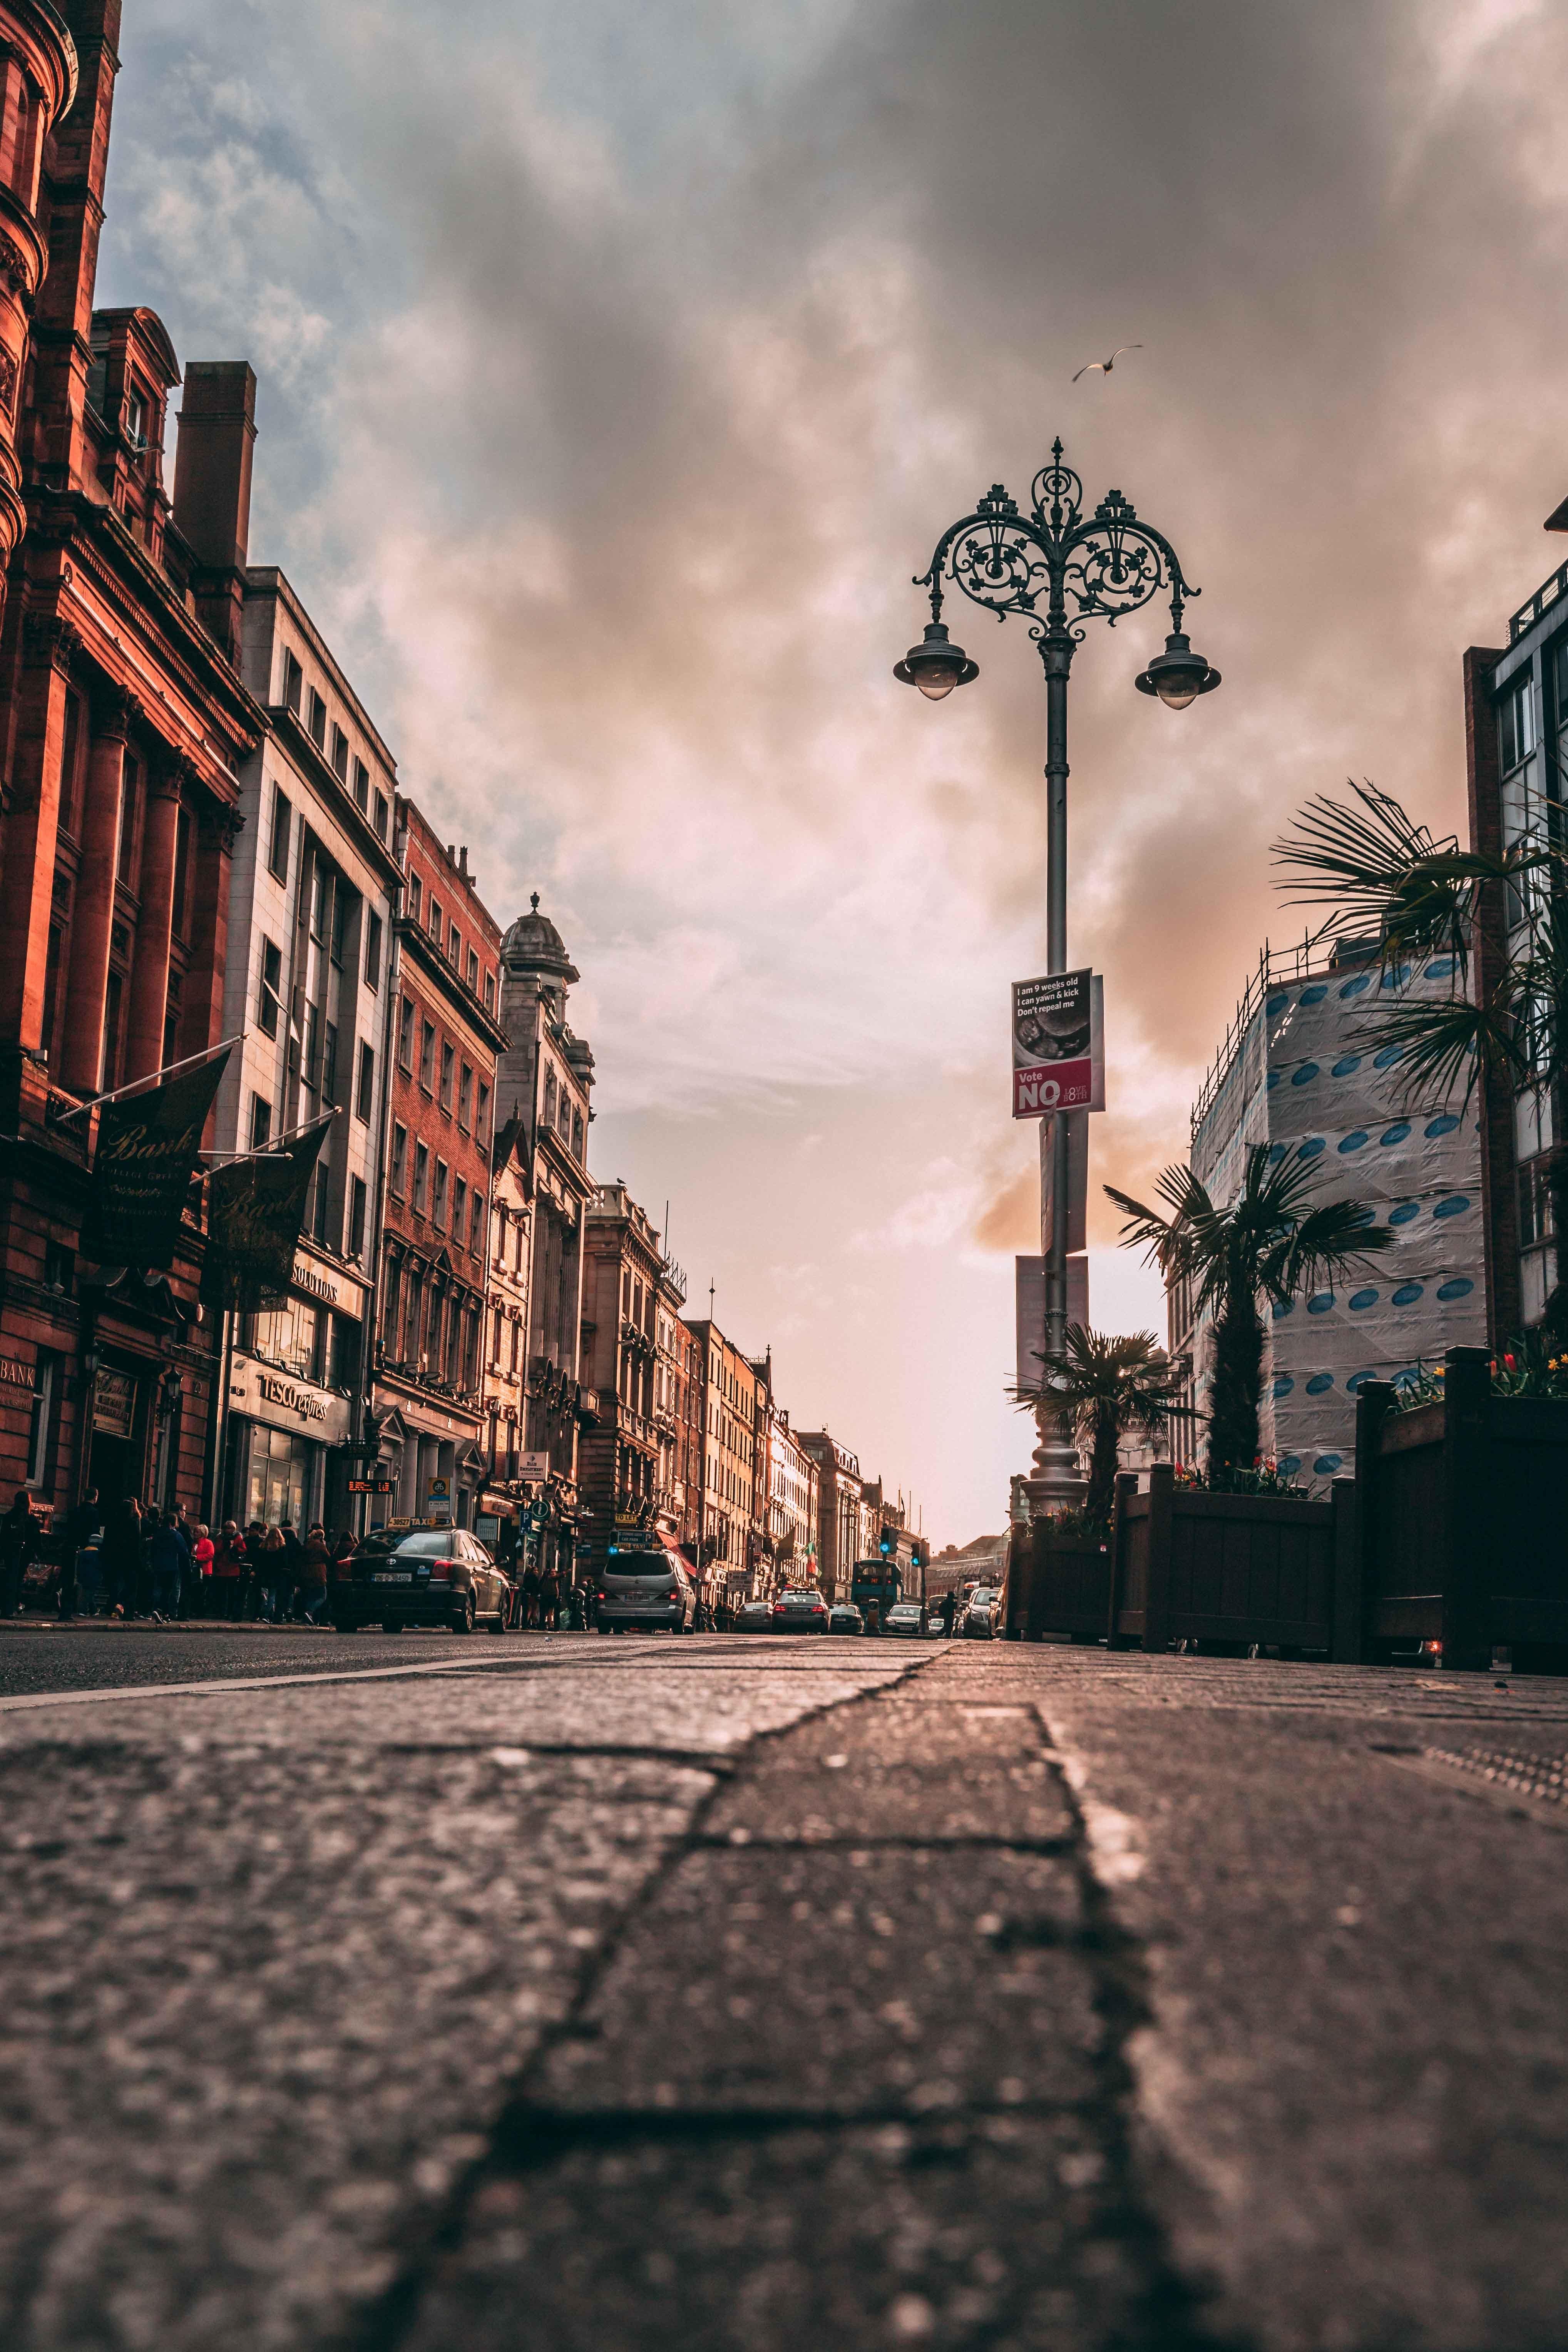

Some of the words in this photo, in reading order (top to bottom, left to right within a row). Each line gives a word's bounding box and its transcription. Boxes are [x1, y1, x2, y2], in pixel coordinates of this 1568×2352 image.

[1021, 986, 1033, 995] am
[1034, 984, 1039, 992] 9
[1041, 981, 1064, 991] weeks
[1066, 977, 1078, 986] old
[1021, 997, 1034, 1005] can
[1036, 994, 1055, 1004] yawn
[1064, 988, 1079, 997] kick
[1017, 1006, 1038, 1017] Don't
[1039, 1001, 1061, 1014] repeal
[1019, 1072, 1043, 1083] Vote
[1019, 1080, 1060, 1109] NO
[100, 1124, 196, 1160] Bank
[293, 1263, 338, 1303] SOLUTIONS
[0, 1360, 34, 1387] BANK
[262, 1374, 297, 1409] TESCO
[298, 1394, 327, 1420] express
[524, 1512, 529, 1523] P
